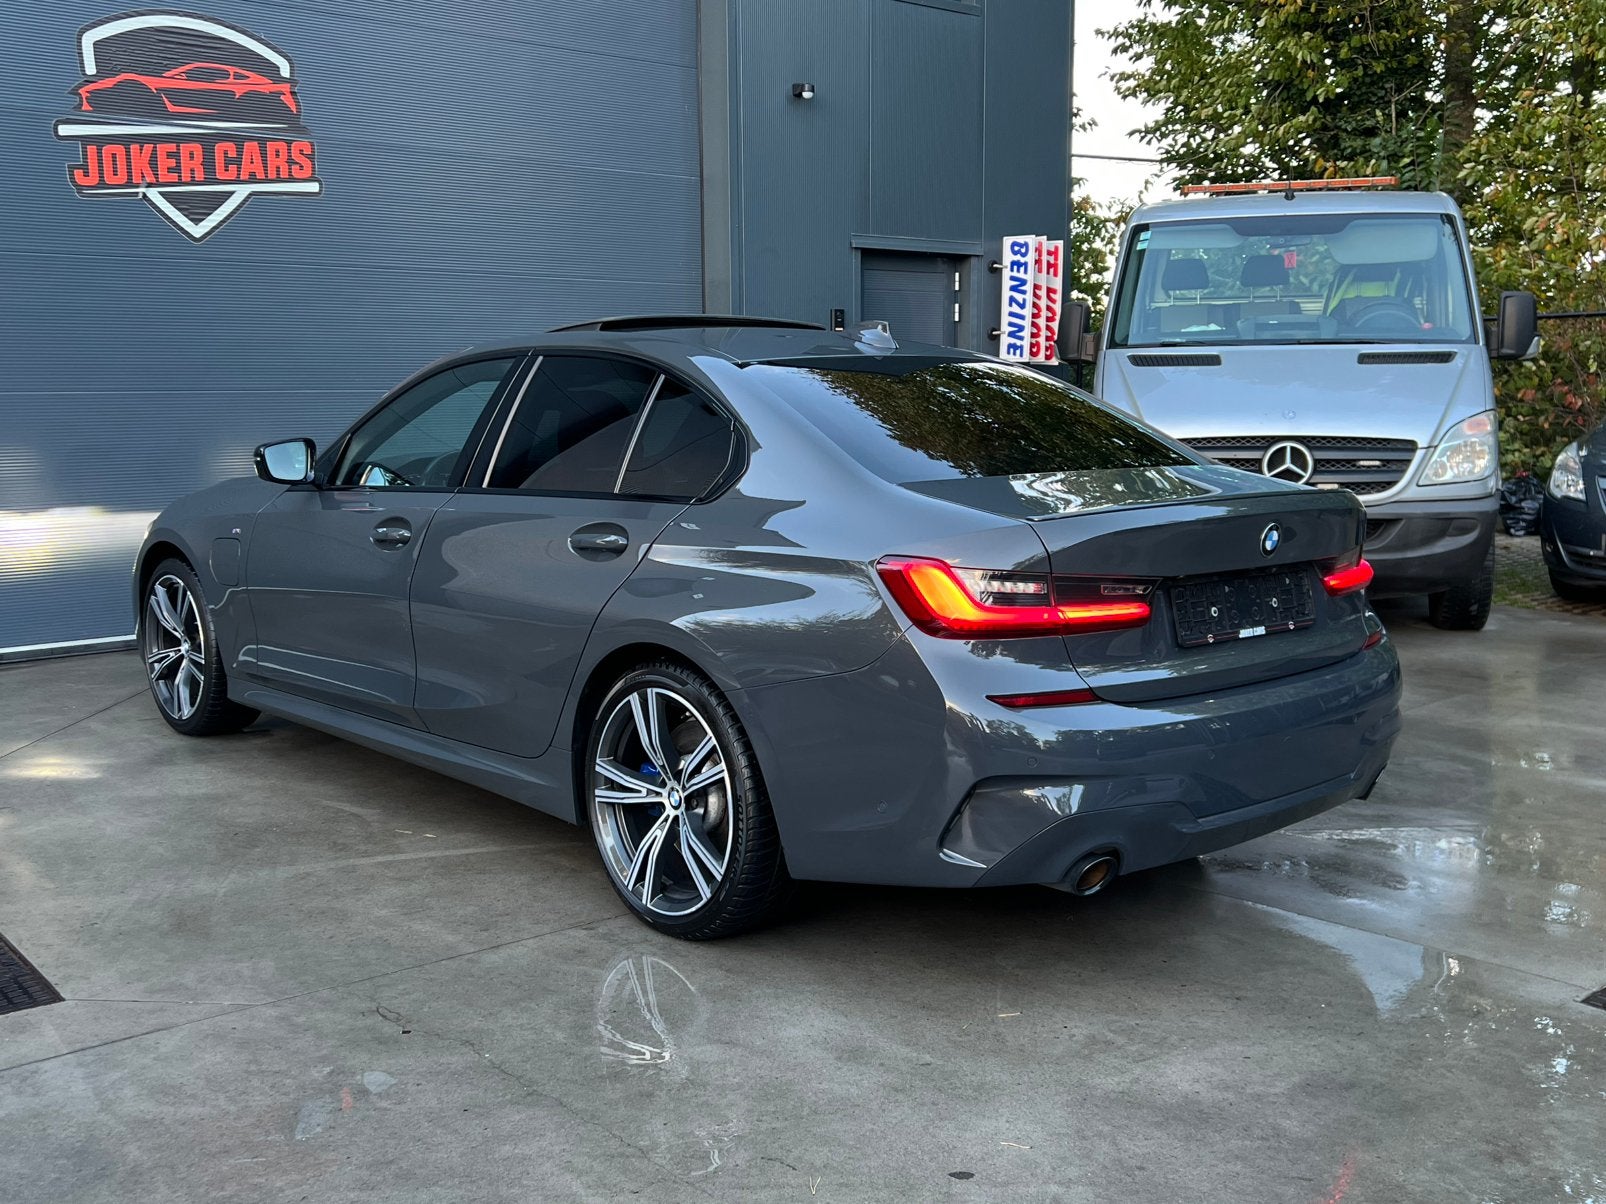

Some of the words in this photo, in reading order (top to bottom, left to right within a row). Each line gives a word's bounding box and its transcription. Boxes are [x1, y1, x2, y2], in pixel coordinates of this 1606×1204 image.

[73, 143, 204, 186] JOKER
[214, 141, 312, 181] CARS
[1007, 240, 1029, 358] BENZINE
